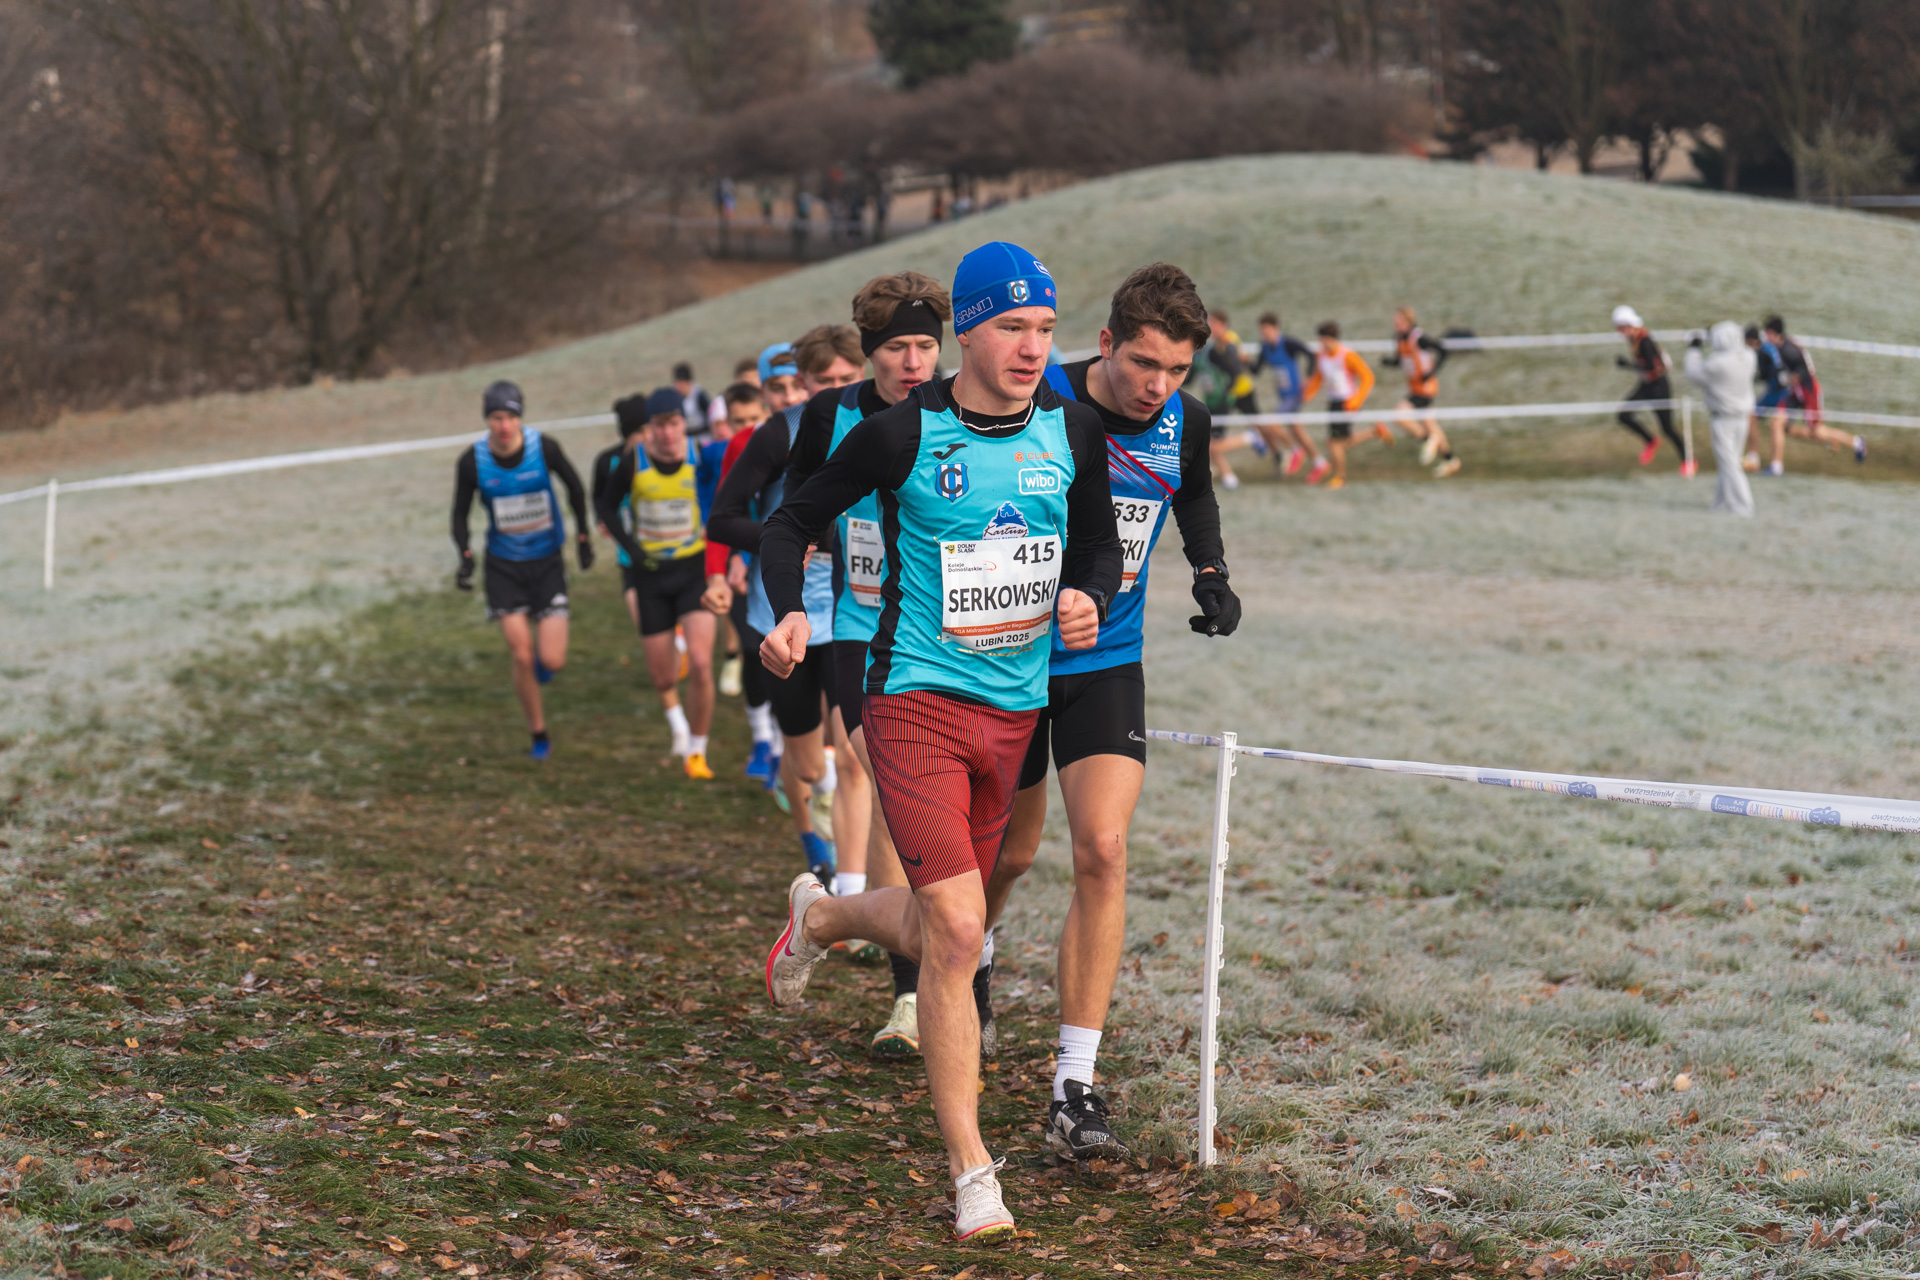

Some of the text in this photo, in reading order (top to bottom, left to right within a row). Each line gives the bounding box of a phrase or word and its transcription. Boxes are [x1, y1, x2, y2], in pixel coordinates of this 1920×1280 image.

[955, 298, 987, 324] GRANIT
[1028, 452, 1055, 460] CUBE
[1150, 442, 1179, 452] OLIMPIA
[1025, 473, 1055, 489] wibo
[1114, 502, 1150, 523] 533
[984, 524, 1029, 538] Kartuzy
[1013, 541, 1055, 565] 415
[1120, 538, 1145, 561] SKI
[851, 555, 884, 576] FRA
[948, 577, 1057, 613] SERKOWSKI
[975, 632, 1030, 648] LUBIN 2025
